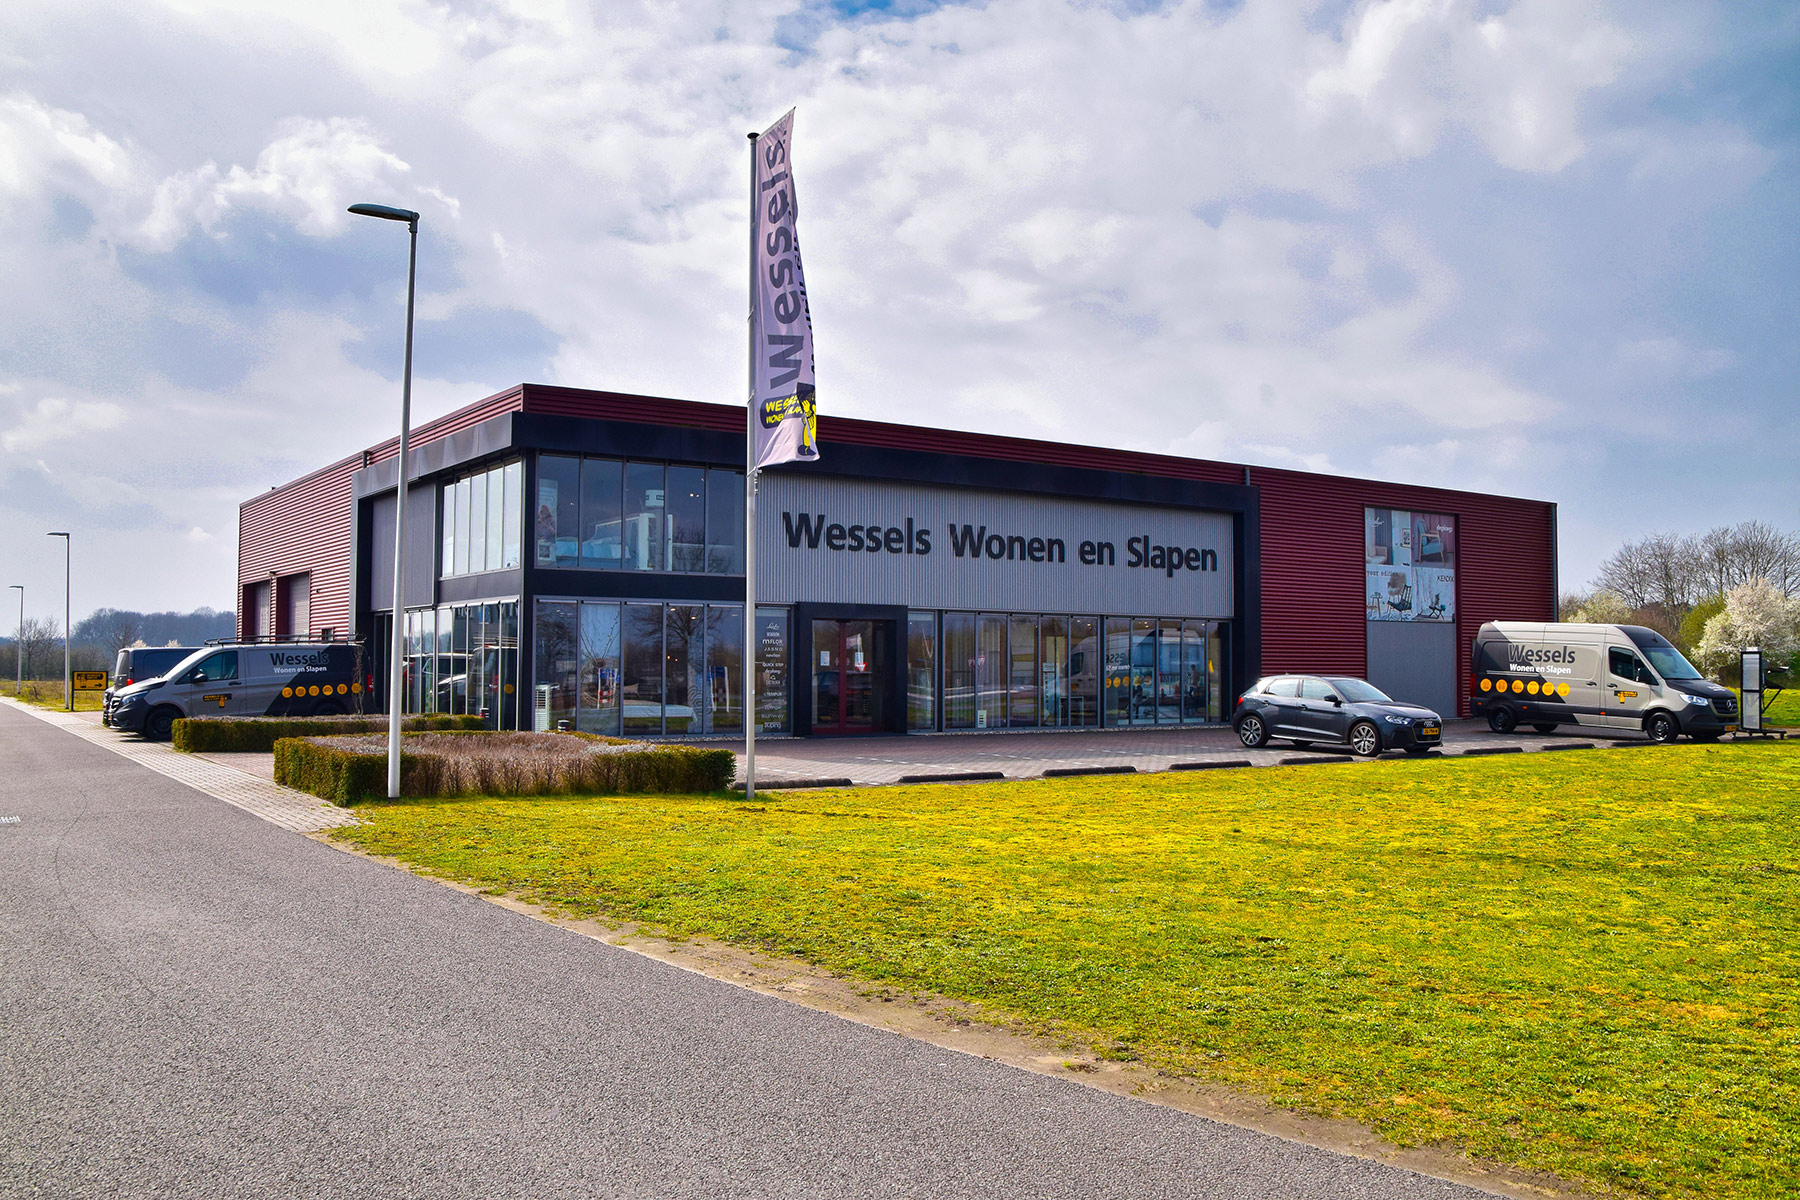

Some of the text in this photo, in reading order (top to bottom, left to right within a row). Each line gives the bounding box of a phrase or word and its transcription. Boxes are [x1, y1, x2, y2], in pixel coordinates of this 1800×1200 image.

[762, 140, 804, 389] Wessels
[783, 512, 1218, 577] Wessels Wonen en Slapen
[270, 651, 329, 666] Wessels
[1508, 644, 1576, 663] Wessels
[1509, 663, 1534, 672] Wonen
[1546, 665, 1571, 675] Slapen
